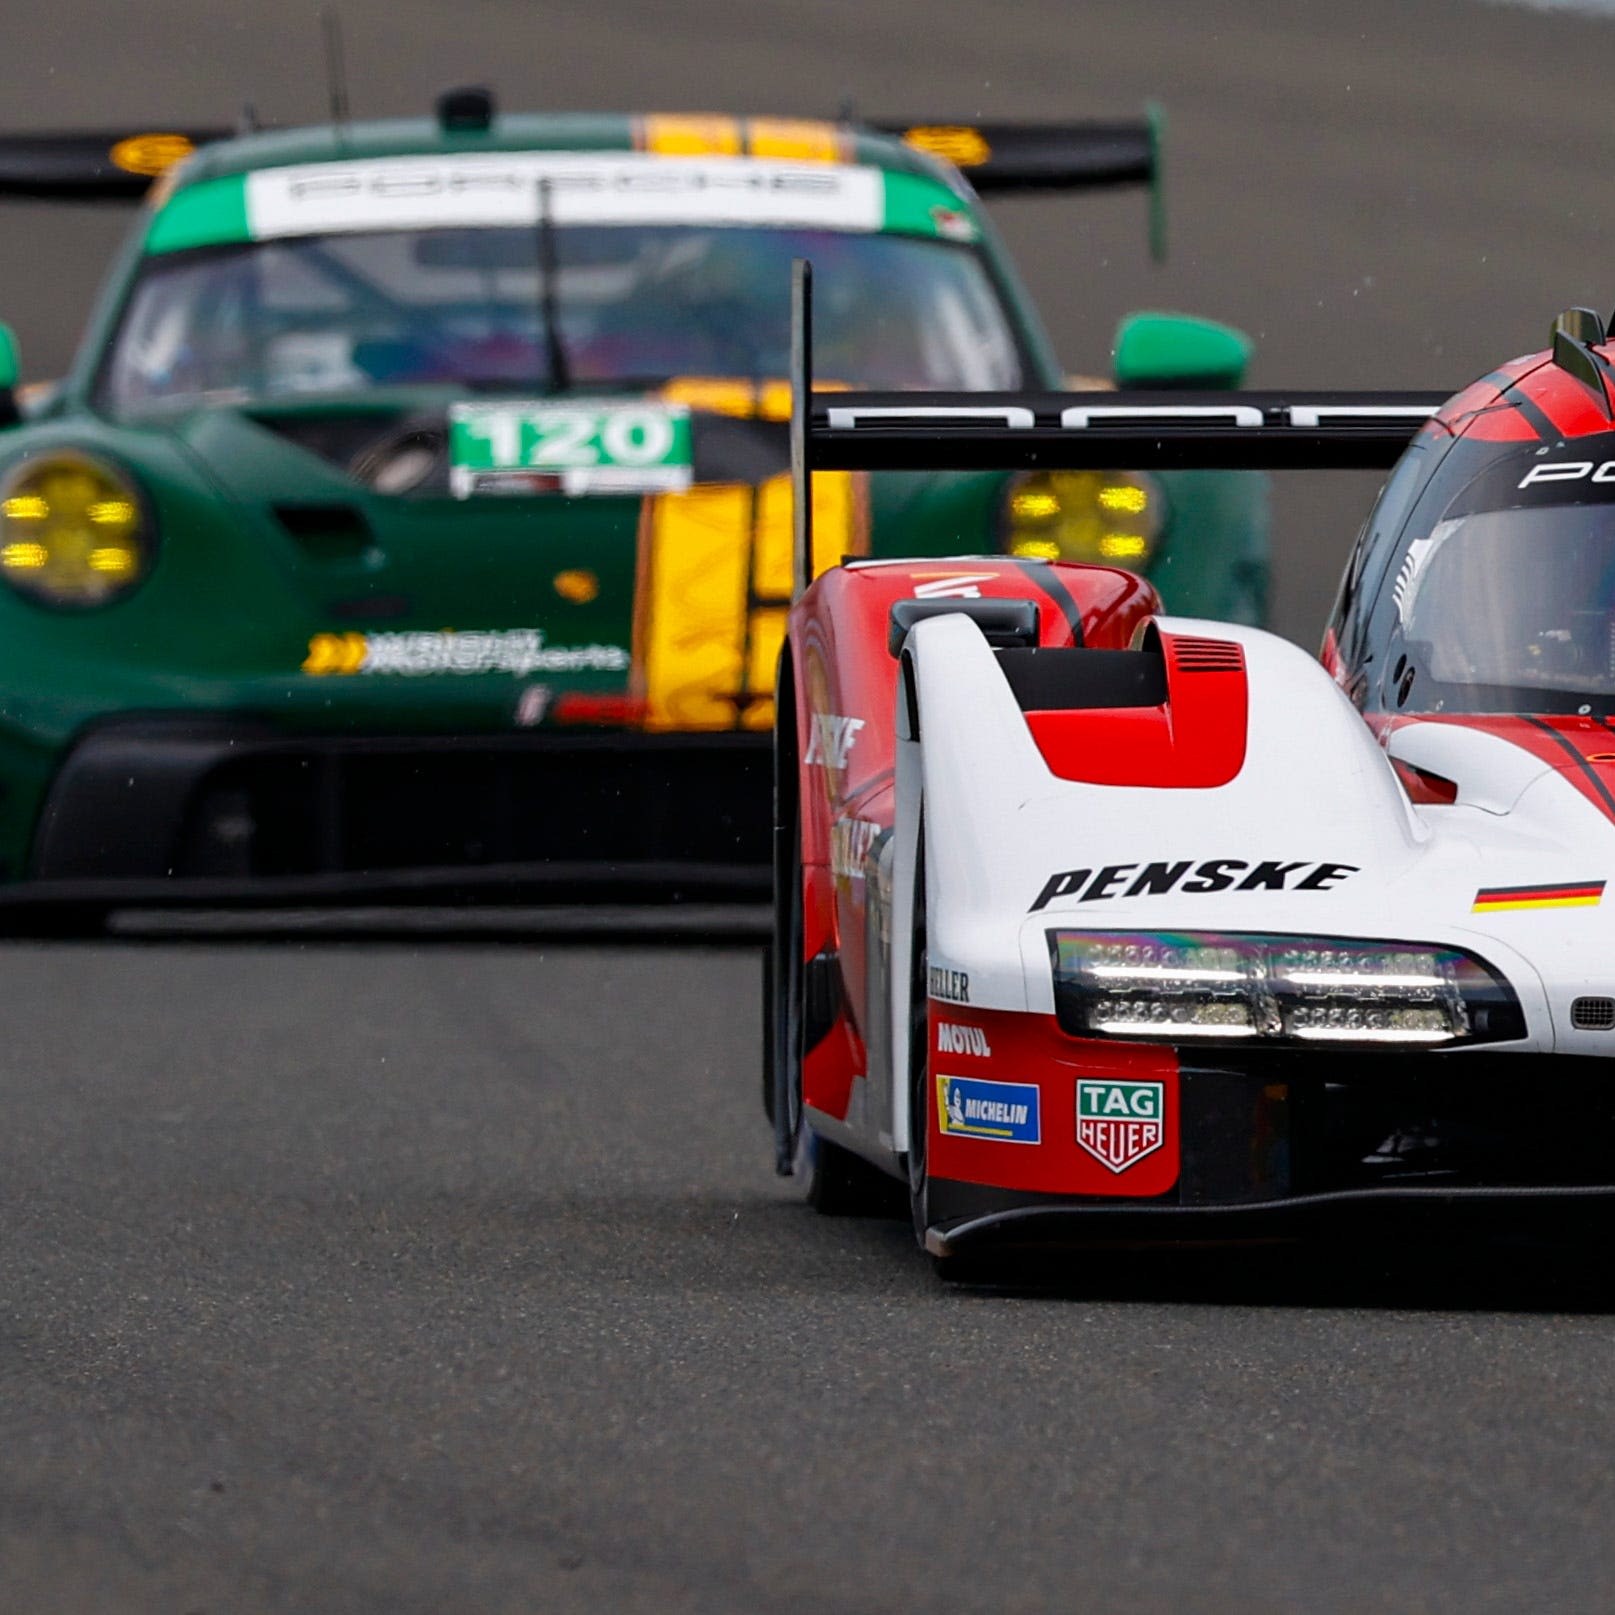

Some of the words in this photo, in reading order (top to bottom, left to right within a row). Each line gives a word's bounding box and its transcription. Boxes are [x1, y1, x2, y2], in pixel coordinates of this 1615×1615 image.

[466, 408, 674, 467] 120
[1027, 858, 1361, 913] PENSKE
[938, 1022, 992, 1058] MOTUL
[965, 1097, 1028, 1126] MICHELIN
[1083, 1086, 1154, 1116] TAG
[1081, 1121, 1156, 1165] HEUER
